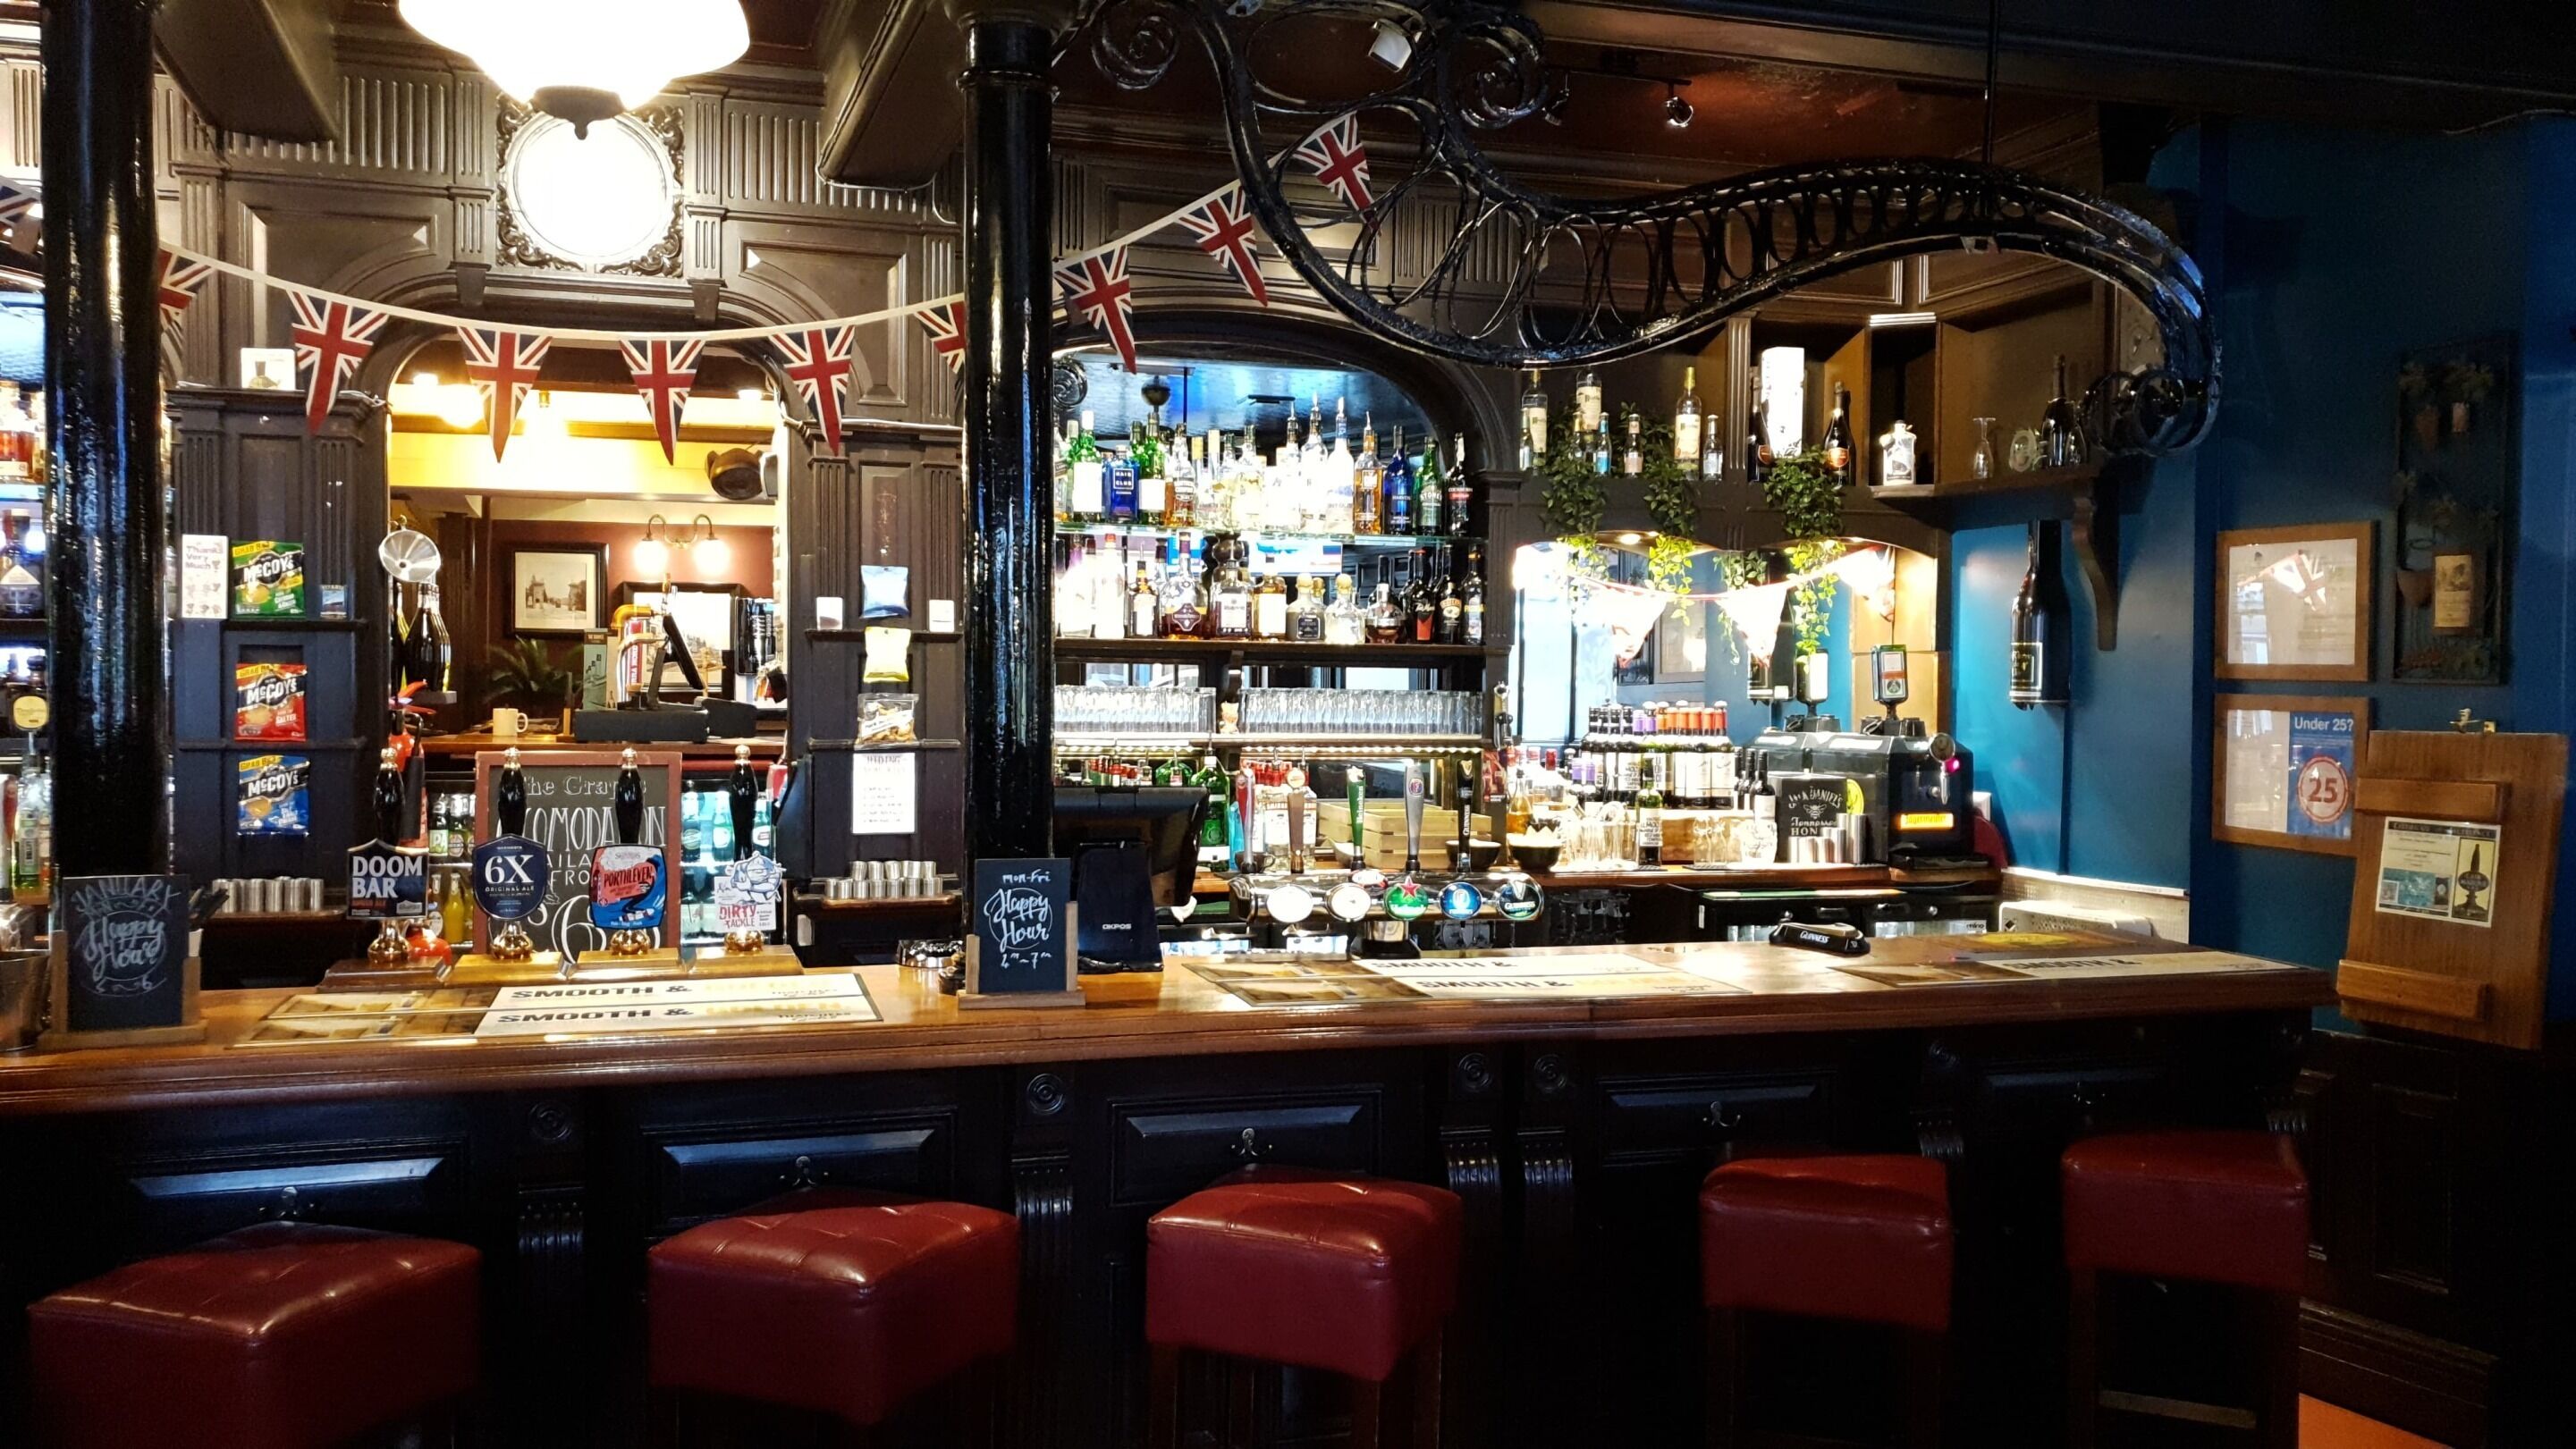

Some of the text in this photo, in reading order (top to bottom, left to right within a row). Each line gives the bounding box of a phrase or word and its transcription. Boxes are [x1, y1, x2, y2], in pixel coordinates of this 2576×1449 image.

[2294, 716, 2353, 731] Under 25?
[2309, 777, 2338, 803] 25
[352, 855, 423, 878] DOOM
[485, 855, 535, 884] 6X
[604, 864, 653, 888] PORTHLEVEN
[351, 877, 399, 899] BAR
[719, 904, 756, 920] DIRTY
[984, 889, 1049, 923] Happy
[725, 917, 756, 929] TACKLE
[1000, 918, 1050, 953] Hour
[1800, 930, 1830, 944] GUINNESS
[511, 987, 654, 998] SMOOTH
[498, 1009, 651, 1023] SMOOTH
[663, 1007, 694, 1015] &
